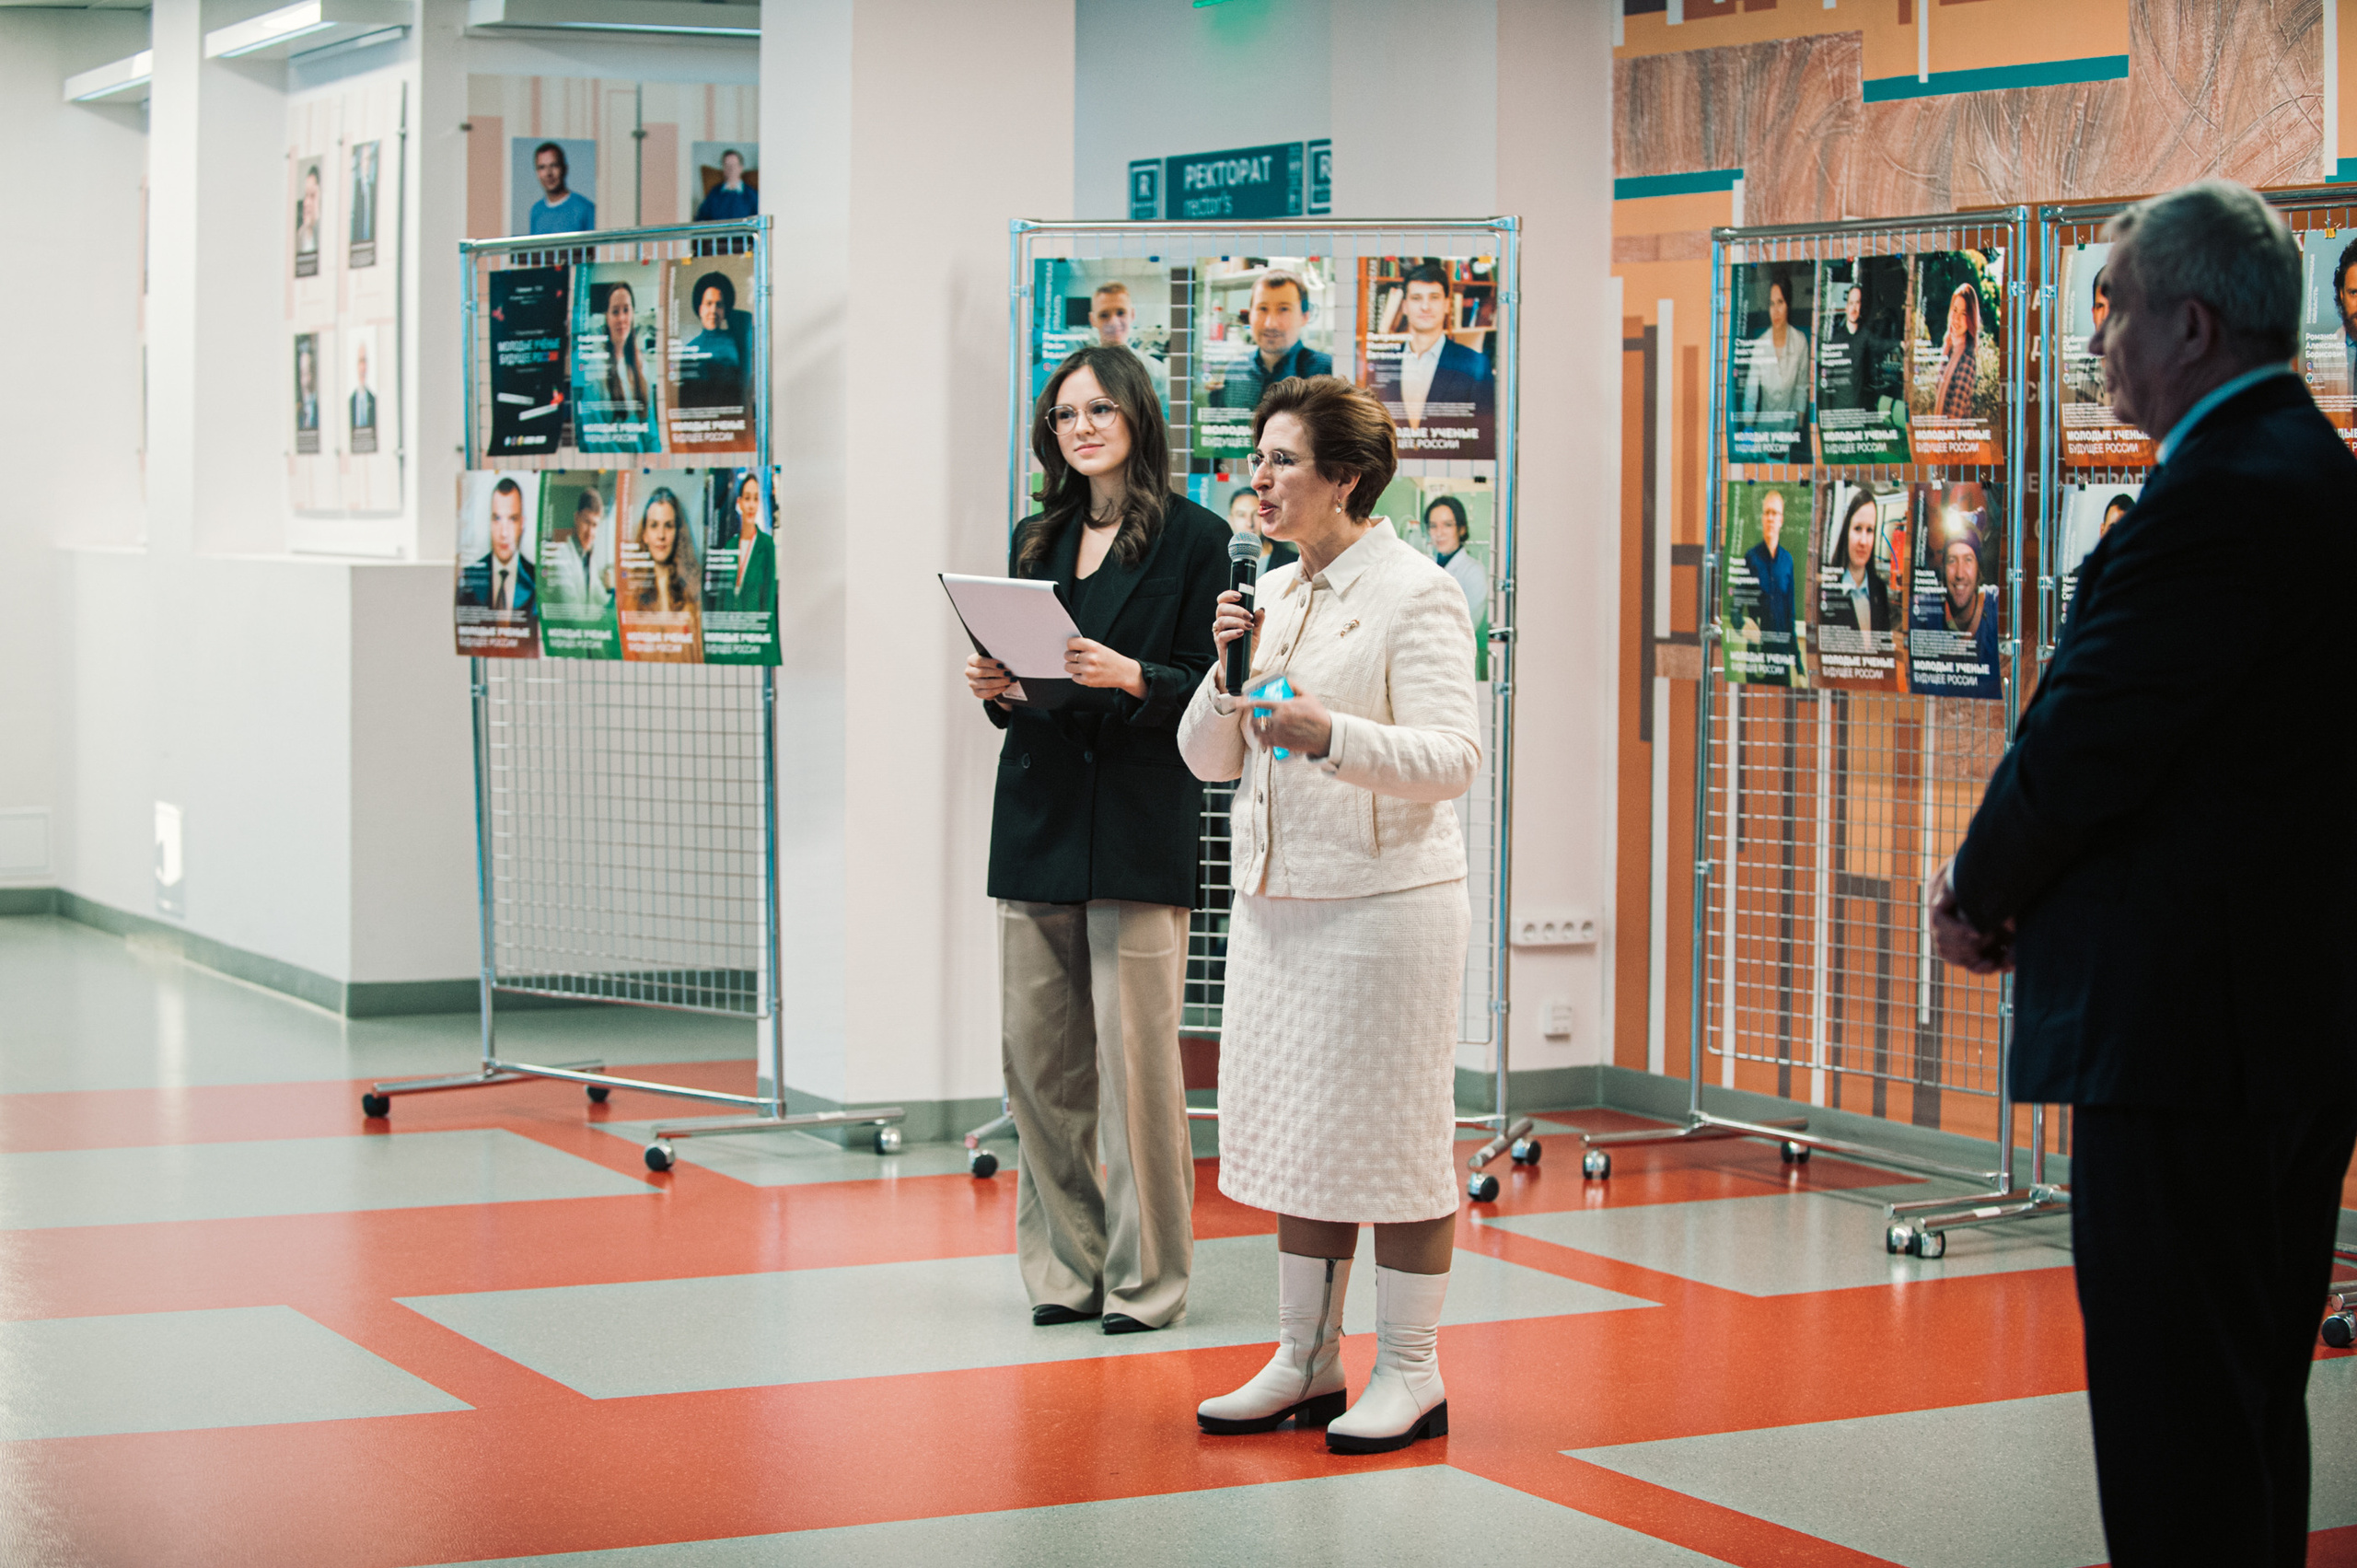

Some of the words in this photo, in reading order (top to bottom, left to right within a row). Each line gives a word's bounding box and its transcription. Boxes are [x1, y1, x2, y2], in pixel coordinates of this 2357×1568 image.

[1184, 155, 1273, 191] РЕКТОРАТ
[2305, 332, 2338, 341] Романов
[2305, 341, 2347, 350] Александр
[2305, 350, 2347, 359] Борисович
[1430, 427, 1480, 439] УЧЕНЫЕ
[1734, 432, 1770, 443] МОЛОДЫЕ
[1771, 431, 1801, 443] УЧЕНЫЕ
[1823, 430, 1864, 443] МОЛОДЫЕ
[1864, 429, 1898, 441] УЧЕНЫЕ
[1914, 430, 1956, 442] МОЛОДЫЕ
[1956, 429, 1991, 441] УЧЕНЫЕ
[2066, 430, 2112, 442] МОЛОДЫЕ
[1416, 439, 1460, 450] РОССИИ
[1824, 443, 1856, 455] БУДУЩЕЕ
[1856, 442, 1887, 454] РОССИИ
[1916, 442, 1948, 454] БУДУЩЕЕ
[1948, 442, 1980, 454] РОССИИ
[2068, 443, 2104, 455] БУДУЩЕЕ
[2105, 442, 2139, 453] РОССИИ
[1821, 654, 1861, 668] МОЛОДЫЕ
[1862, 656, 1896, 669] УЧЕНЫЕ
[1913, 659, 1955, 673] МОЛОДЫЕ
[1956, 662, 1991, 675] УЧЕНЫЕ
[1822, 666, 1853, 679] БУДУЩЕЕ
[1854, 668, 1884, 679] РОССИИ
[1914, 671, 1946, 686] БУДУЩЕЕ
[1947, 674, 1979, 686] РОССИИ
